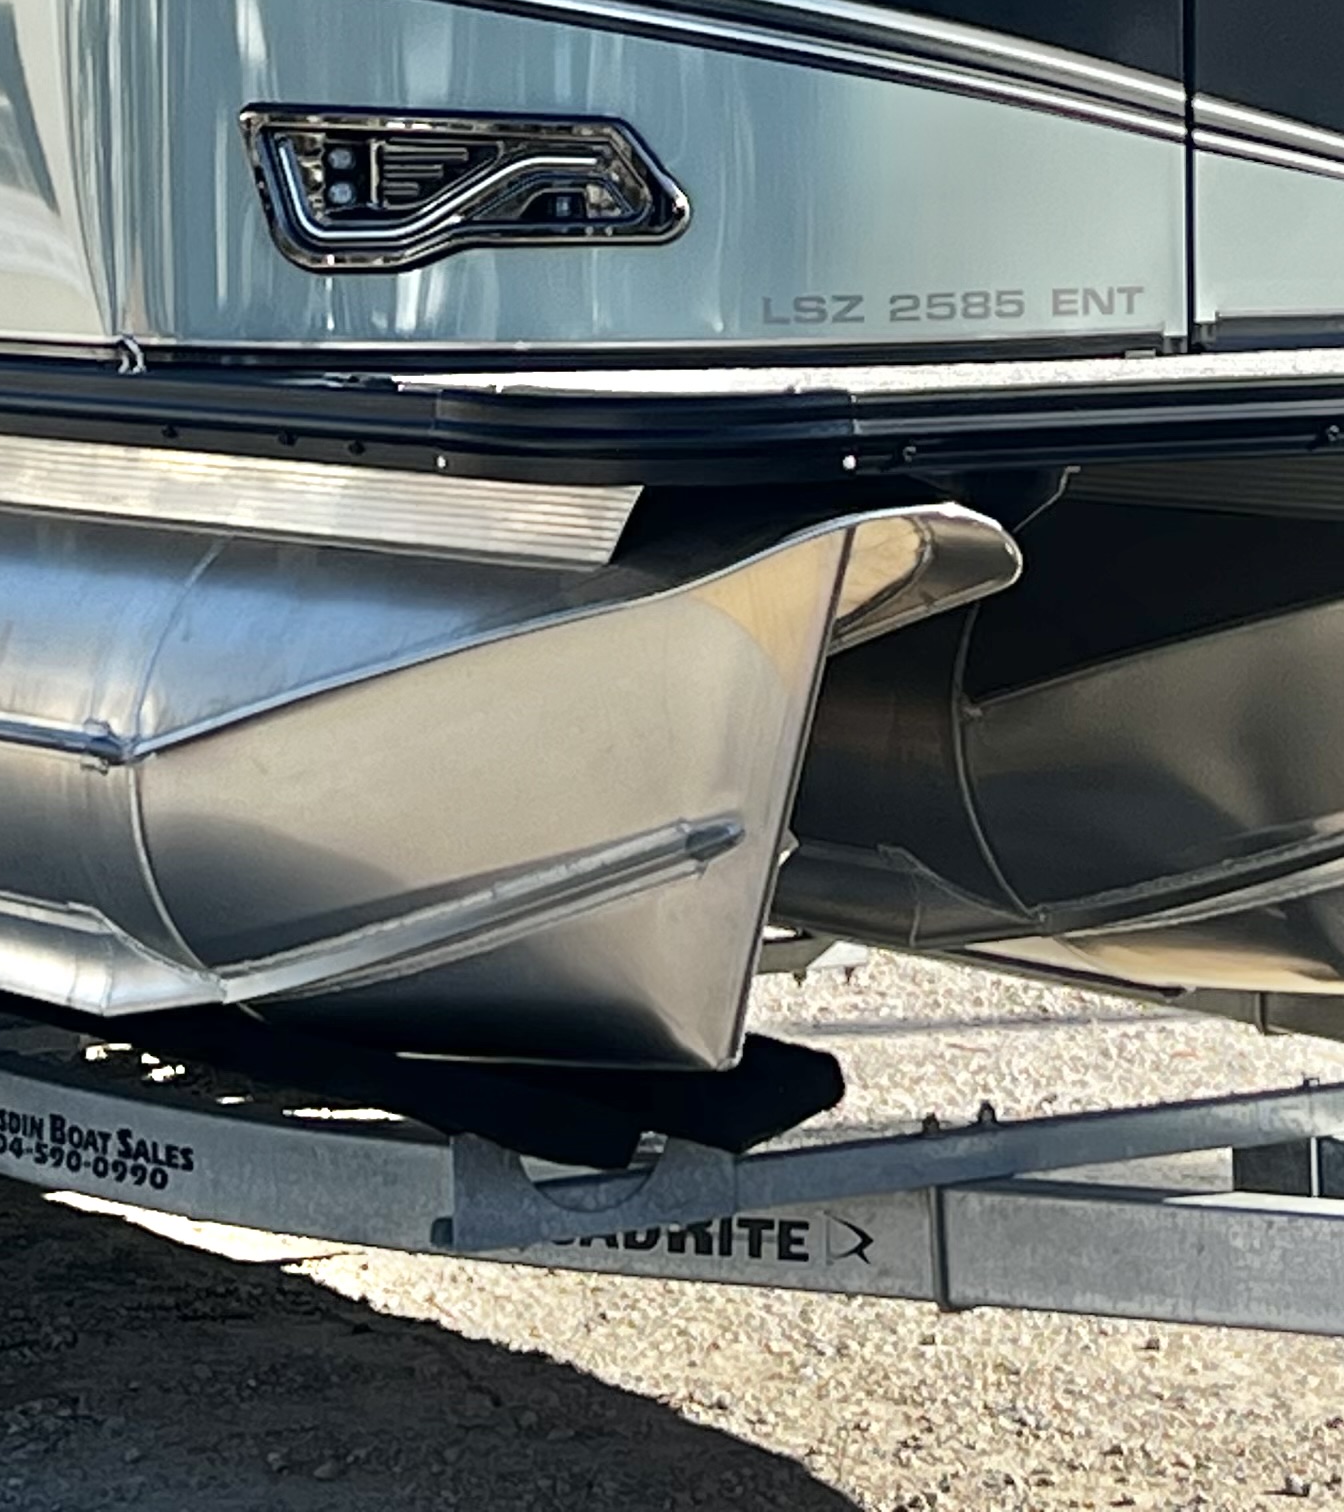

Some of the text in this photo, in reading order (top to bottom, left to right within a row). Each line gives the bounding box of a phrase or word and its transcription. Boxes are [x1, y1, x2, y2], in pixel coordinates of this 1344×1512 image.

[762, 286, 1144, 324] LSZ 2585 ENT
